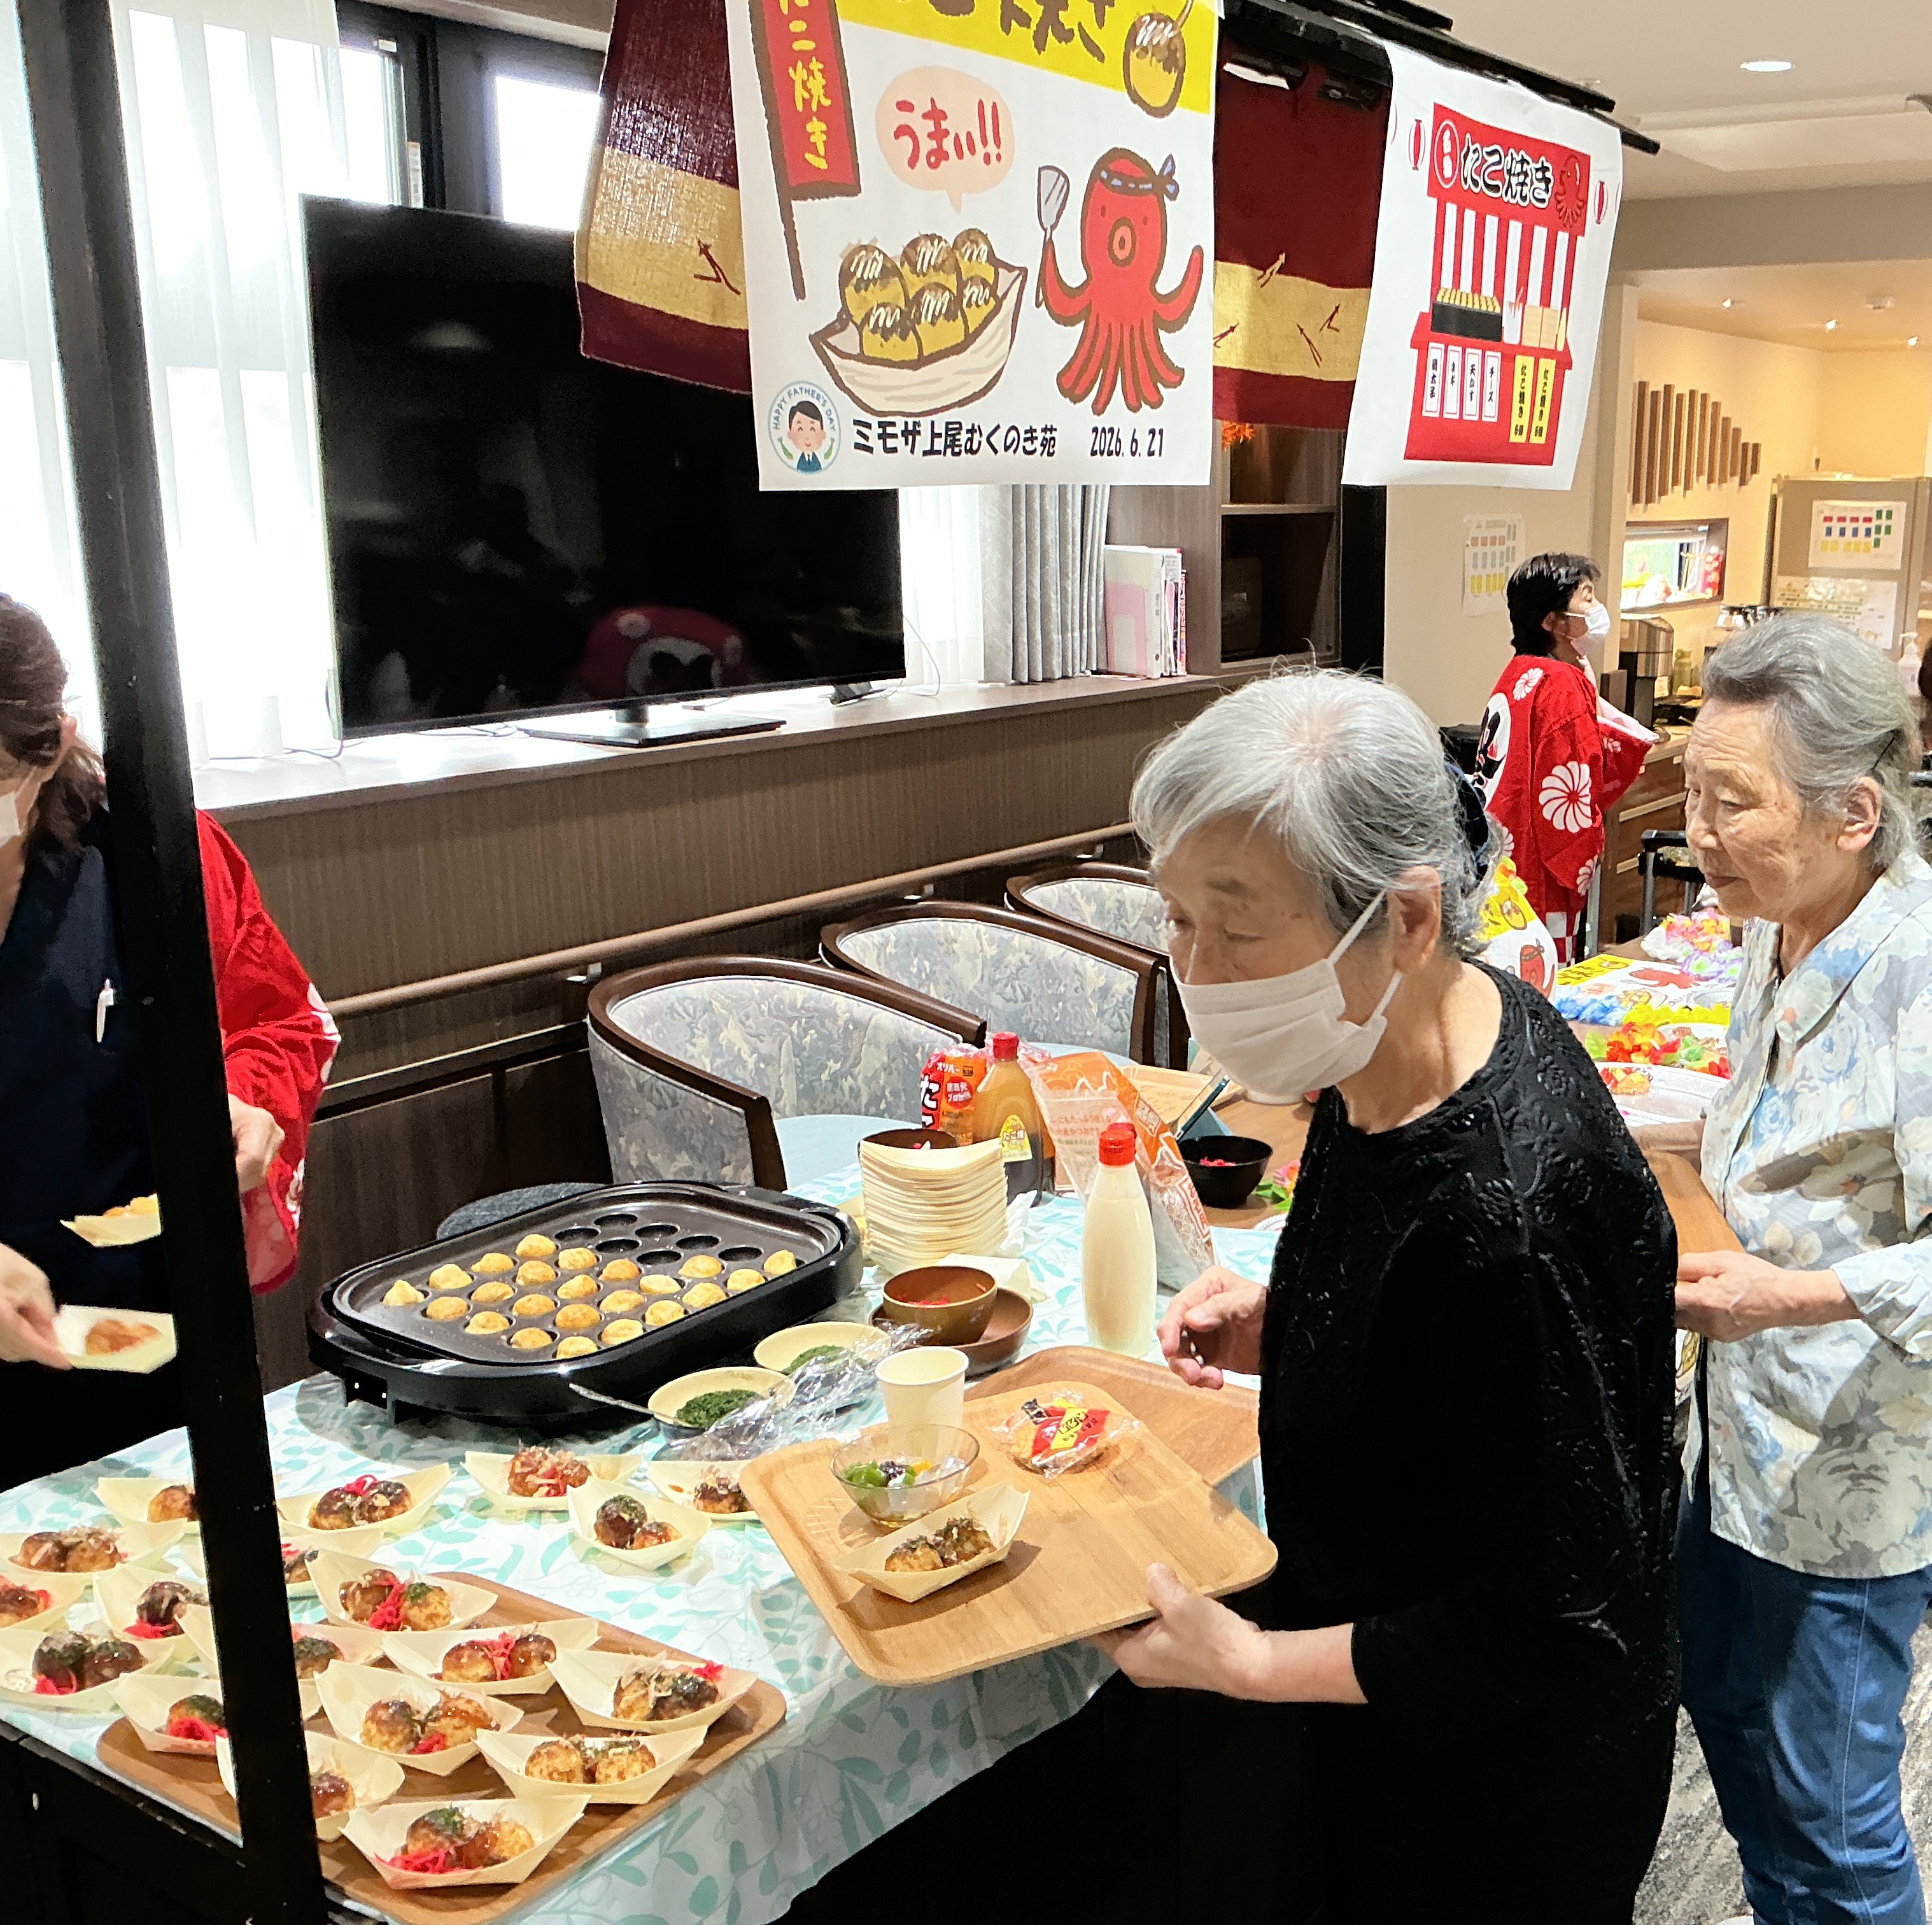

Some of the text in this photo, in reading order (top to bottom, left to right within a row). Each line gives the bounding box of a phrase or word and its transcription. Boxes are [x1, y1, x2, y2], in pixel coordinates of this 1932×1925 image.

[779, 0, 832, 169] こ焼き
[1460, 132, 1555, 209] たこ焼き
[772, 386, 836, 432] HAPPY FATHER'S DAY
[852, 418, 1057, 457] ミモザ上尾むくのき苑
[936, 1061, 961, 1074] オリバー
